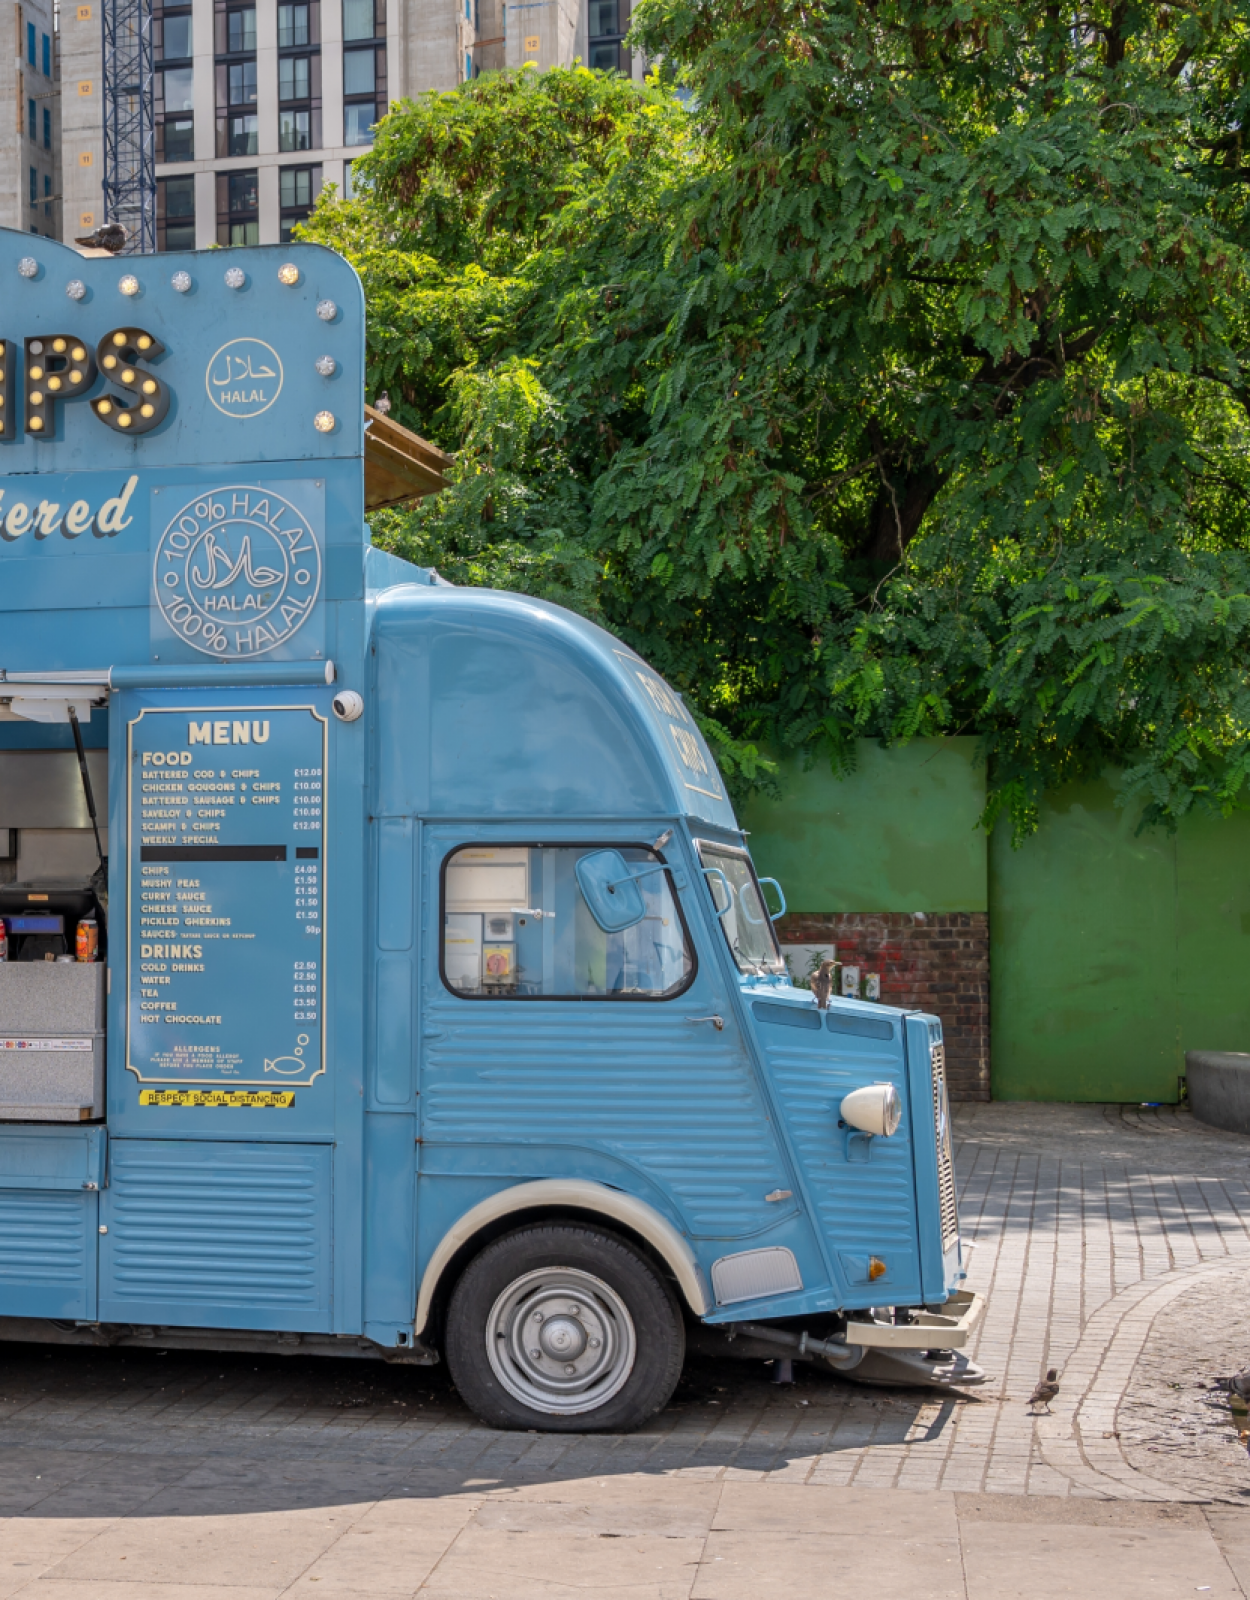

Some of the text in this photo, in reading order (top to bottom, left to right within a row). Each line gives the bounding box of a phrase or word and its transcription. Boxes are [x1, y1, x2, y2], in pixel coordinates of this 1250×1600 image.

[220, 389, 268, 404] HALAL
[163, 493, 313, 565] 100% HALAL
[204, 594, 268, 611] HALAL
[165, 594, 312, 652] 100% HALAL
[190, 721, 269, 743] MENU
[143, 751, 192, 765] FOOD
[194, 770, 214, 778] COD
[143, 796, 188, 804] BATTERED
[194, 796, 234, 804] SAUSAGE
[252, 796, 280, 804] CHIPS
[294, 808, 320, 816] £10.00
[142, 879, 199, 887] MUSHY PEAS
[142, 892, 170, 900] CURRY
[306, 926, 321, 935] 50p
[141, 945, 202, 958] DRINKS
[141, 963, 167, 971] COLD
[294, 972, 316, 980] £2.50
[141, 1002, 176, 1010] COFFEE
[149, 1094, 286, 1104] RESPECT SOCIAL DISTANCING
